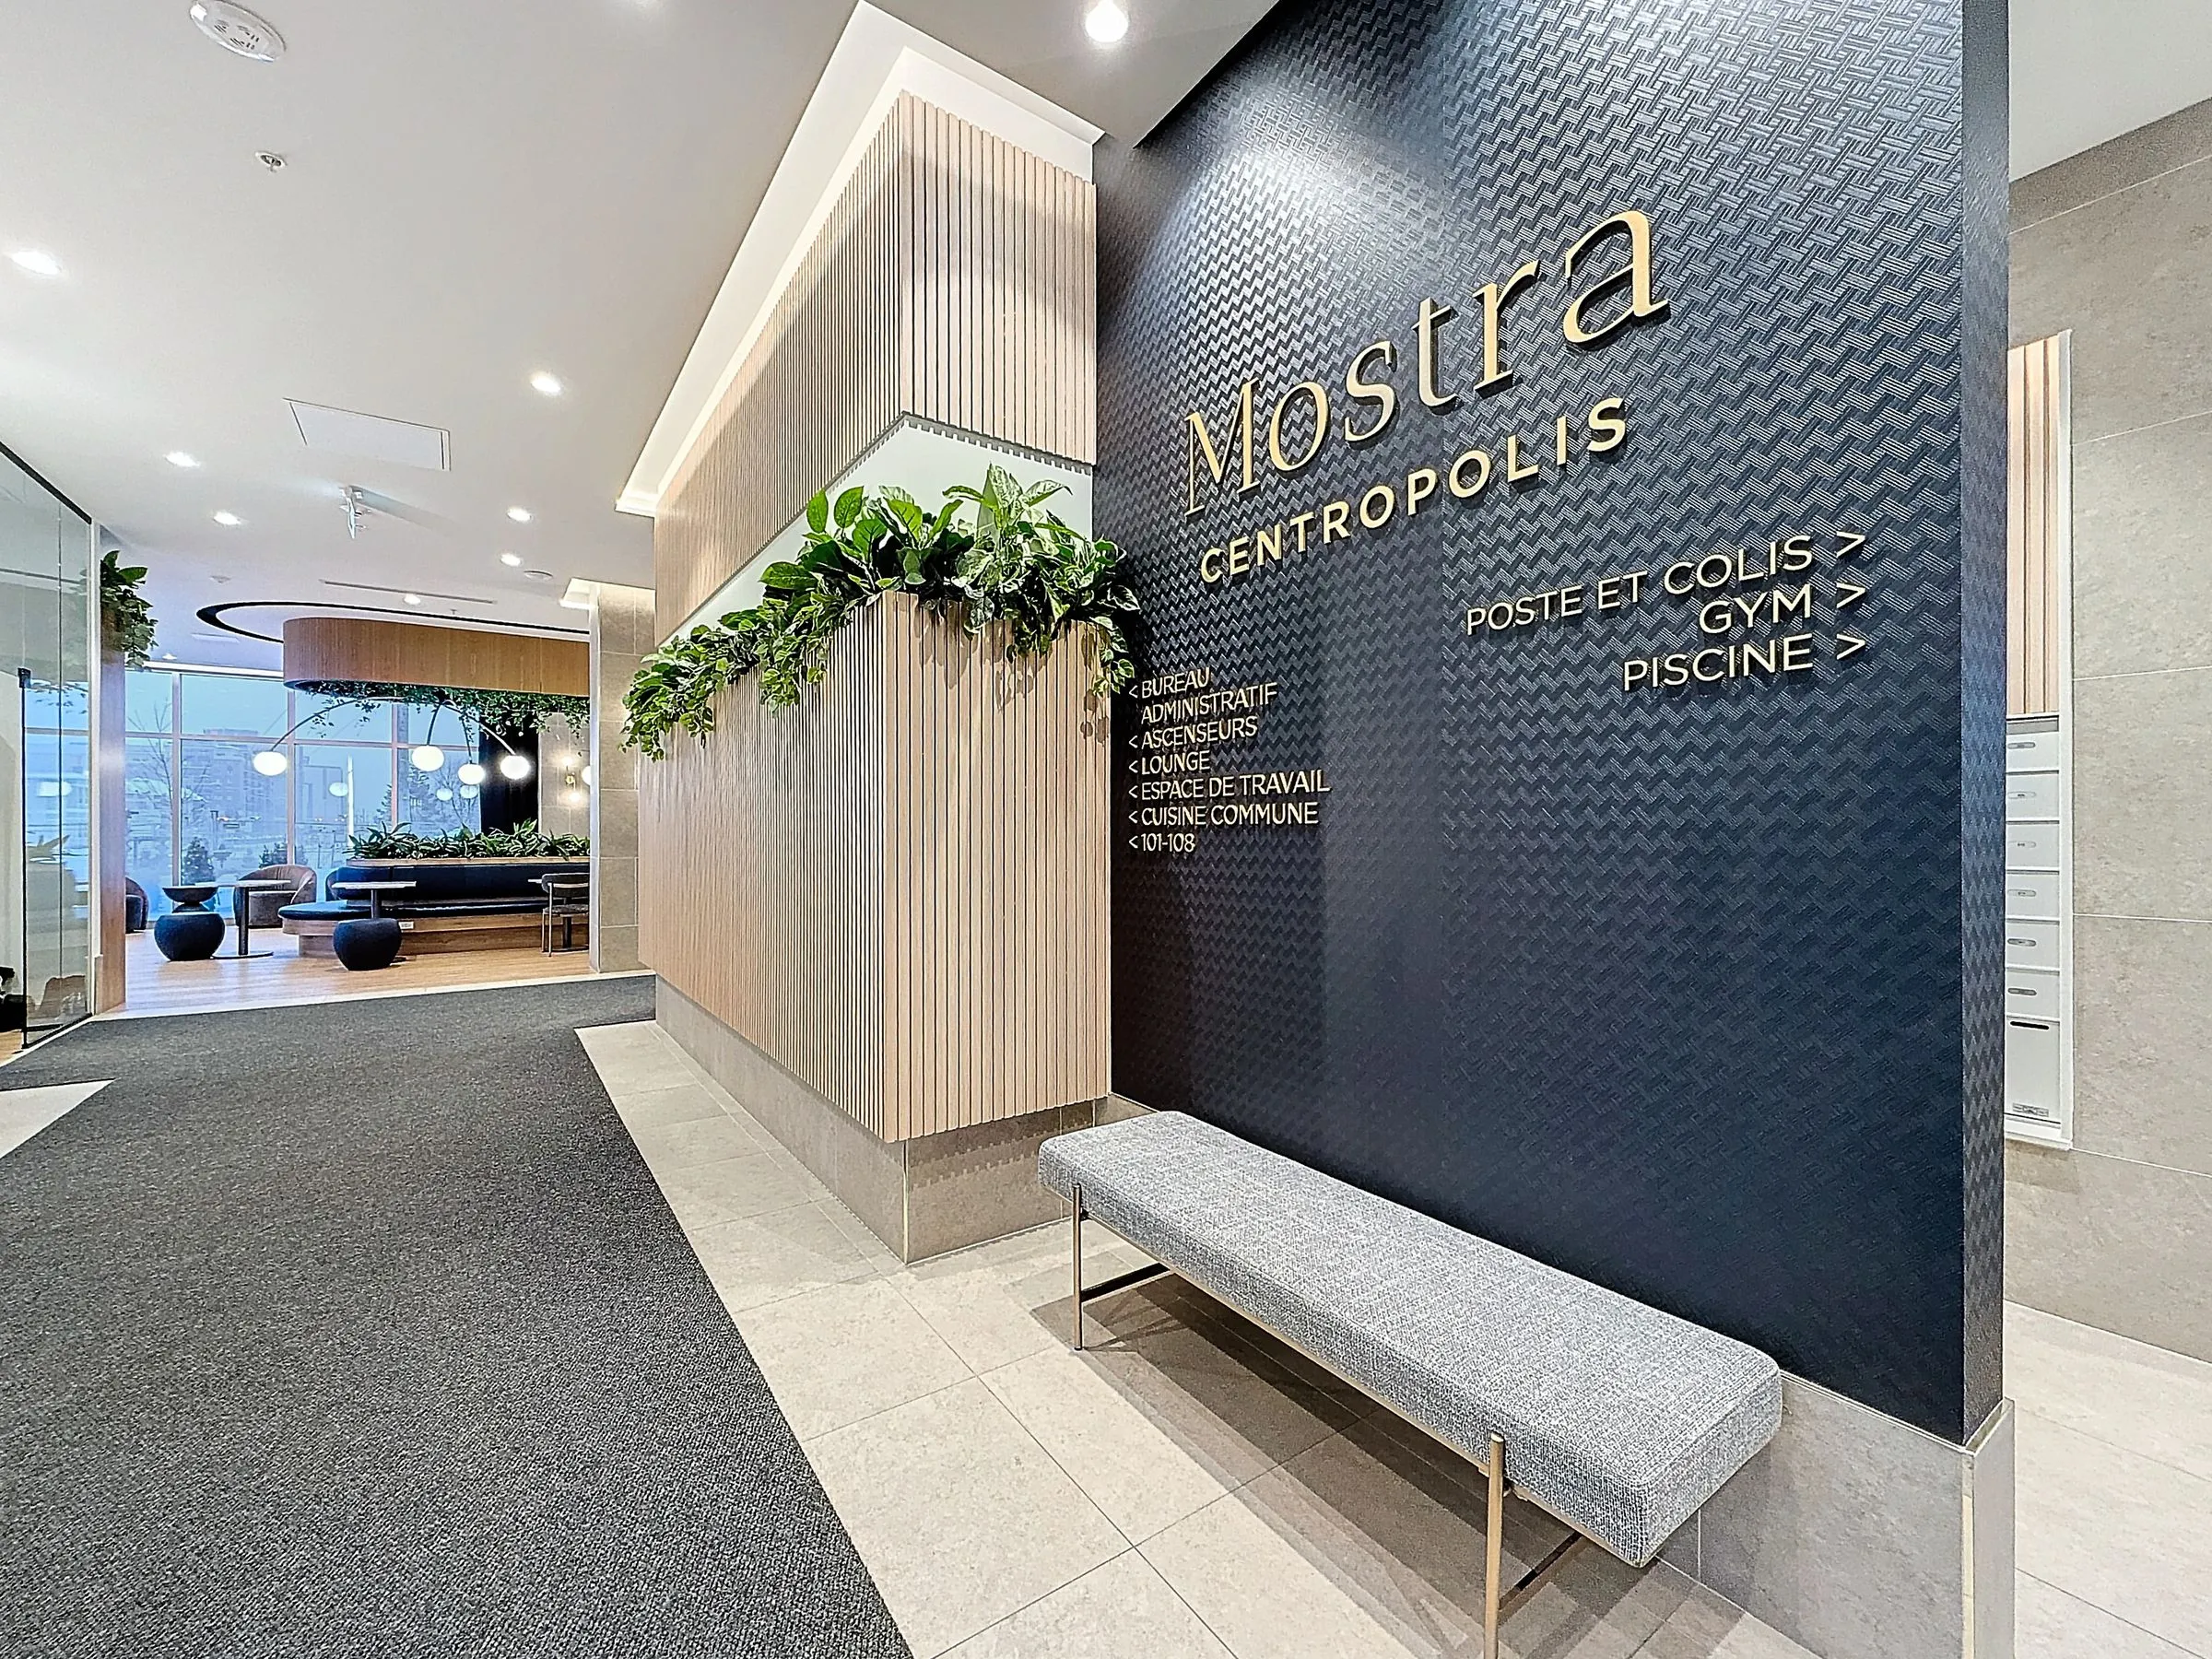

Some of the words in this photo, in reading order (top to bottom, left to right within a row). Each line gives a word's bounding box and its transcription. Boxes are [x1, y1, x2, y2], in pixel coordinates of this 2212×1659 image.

[1183, 209, 1669, 518] Mostra
[1200, 397, 1629, 583] CENTROPOLIS
[1466, 584, 1583, 636] POSTE
[1597, 571, 1649, 609] ET
[1664, 535, 1813, 594] COLIS
[1700, 583, 1812, 633] GYM
[1623, 632, 1814, 691] PISCINE
[1141, 666, 1210, 699] BUREAU
[1141, 681, 1278, 725] ADMINISTRATIF
[1141, 715, 1259, 750] ASCENSEURS
[1141, 749, 1211, 776] LOUNGE
[1141, 778, 1205, 801] ESPACE
[1208, 775, 1235, 798] DE
[1239, 769, 1331, 796] TRAVAIL
[1141, 806, 1207, 826] CUISINE
[1210, 801, 1320, 826] COMMUNE
[1141, 832, 1196, 853] 101-108
